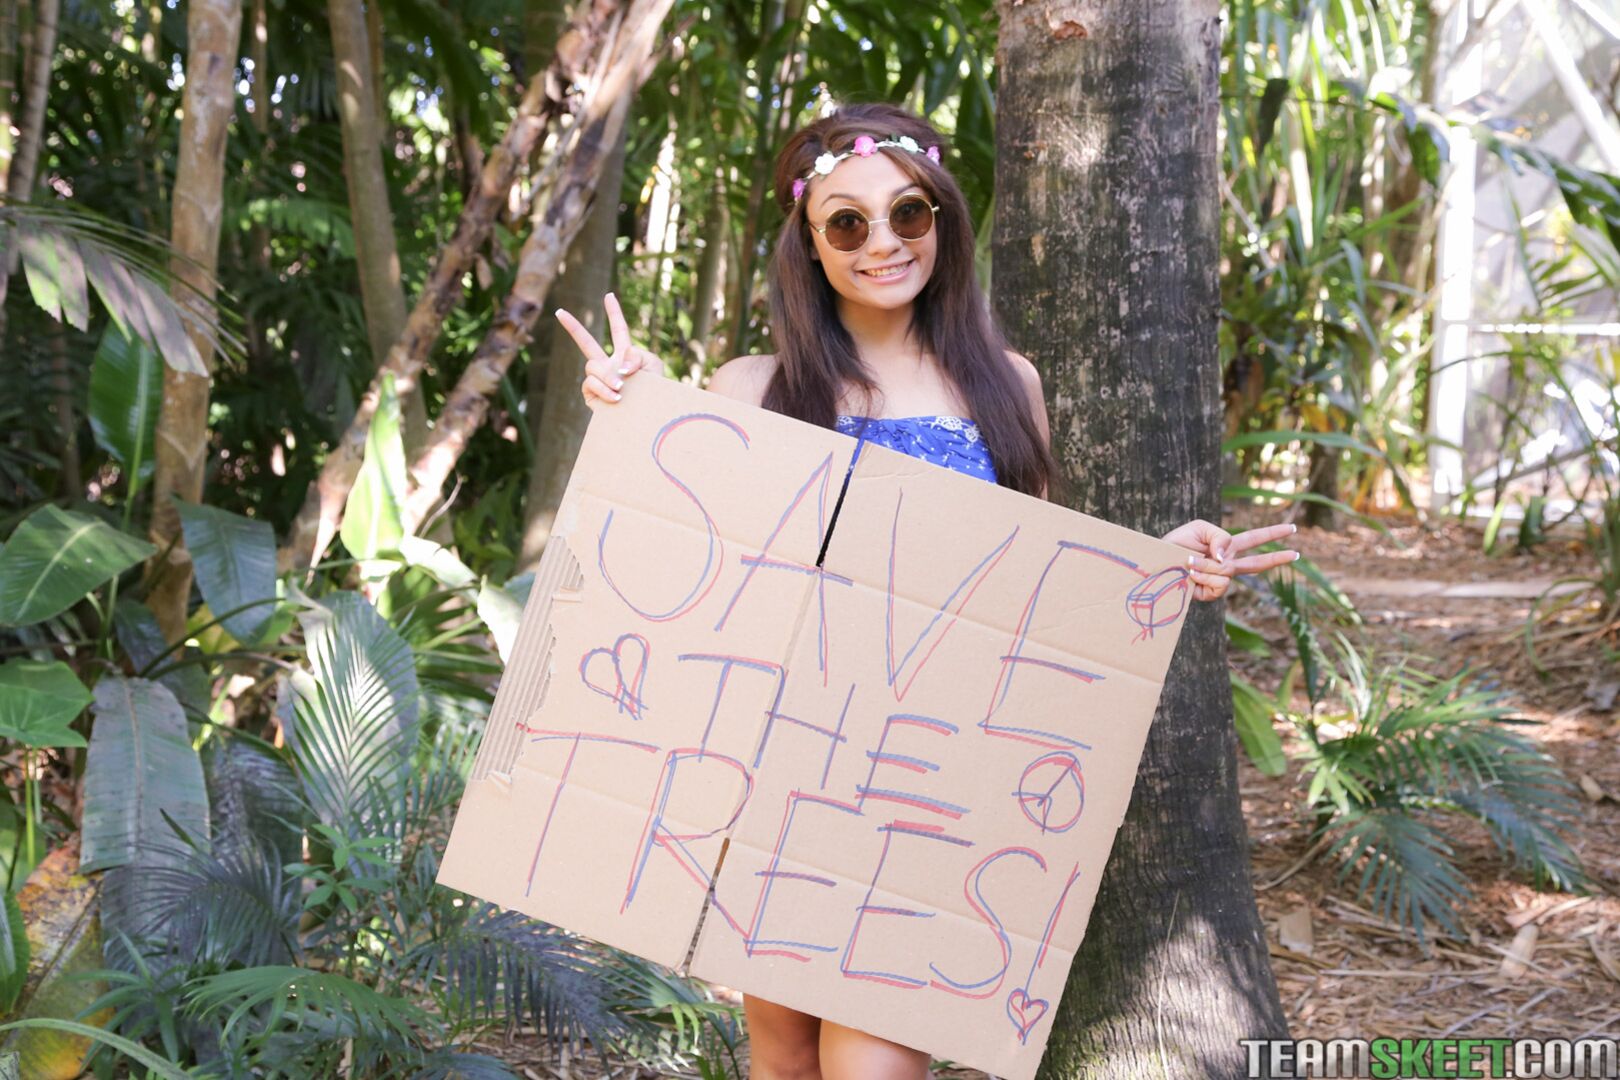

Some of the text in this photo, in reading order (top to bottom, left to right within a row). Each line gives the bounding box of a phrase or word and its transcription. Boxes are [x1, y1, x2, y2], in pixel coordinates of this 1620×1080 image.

[597, 412, 1151, 751] SAVE
[677, 653, 971, 820] THE
[515, 722, 1081, 1045] TREES!
